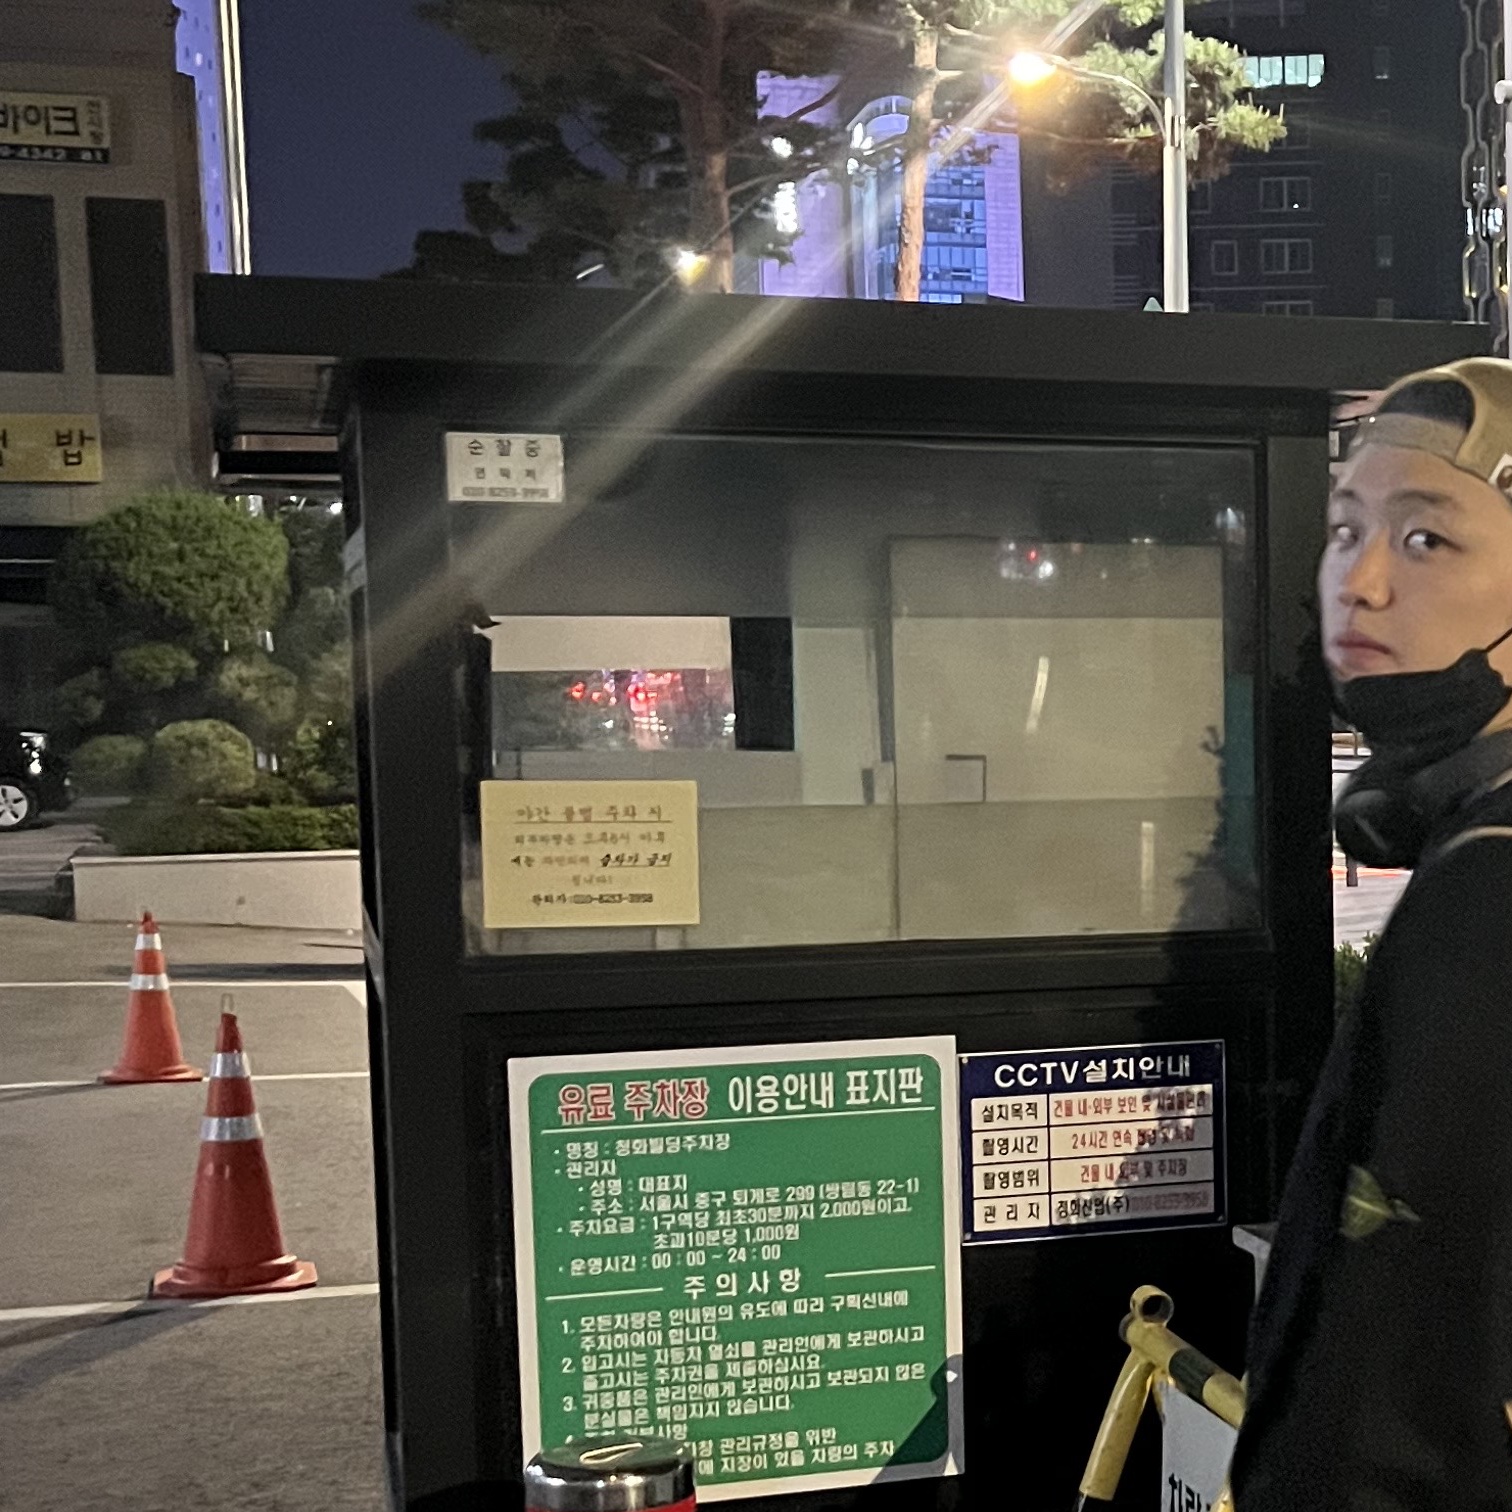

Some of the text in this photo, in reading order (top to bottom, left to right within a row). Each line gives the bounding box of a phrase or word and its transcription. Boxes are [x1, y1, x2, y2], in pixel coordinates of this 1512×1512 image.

[559, 1066, 923, 1125] 유료 주차장 이용안내 표지판
[982, 1101, 1038, 1123] 설치목적
[785, 1184, 816, 1203] 299
